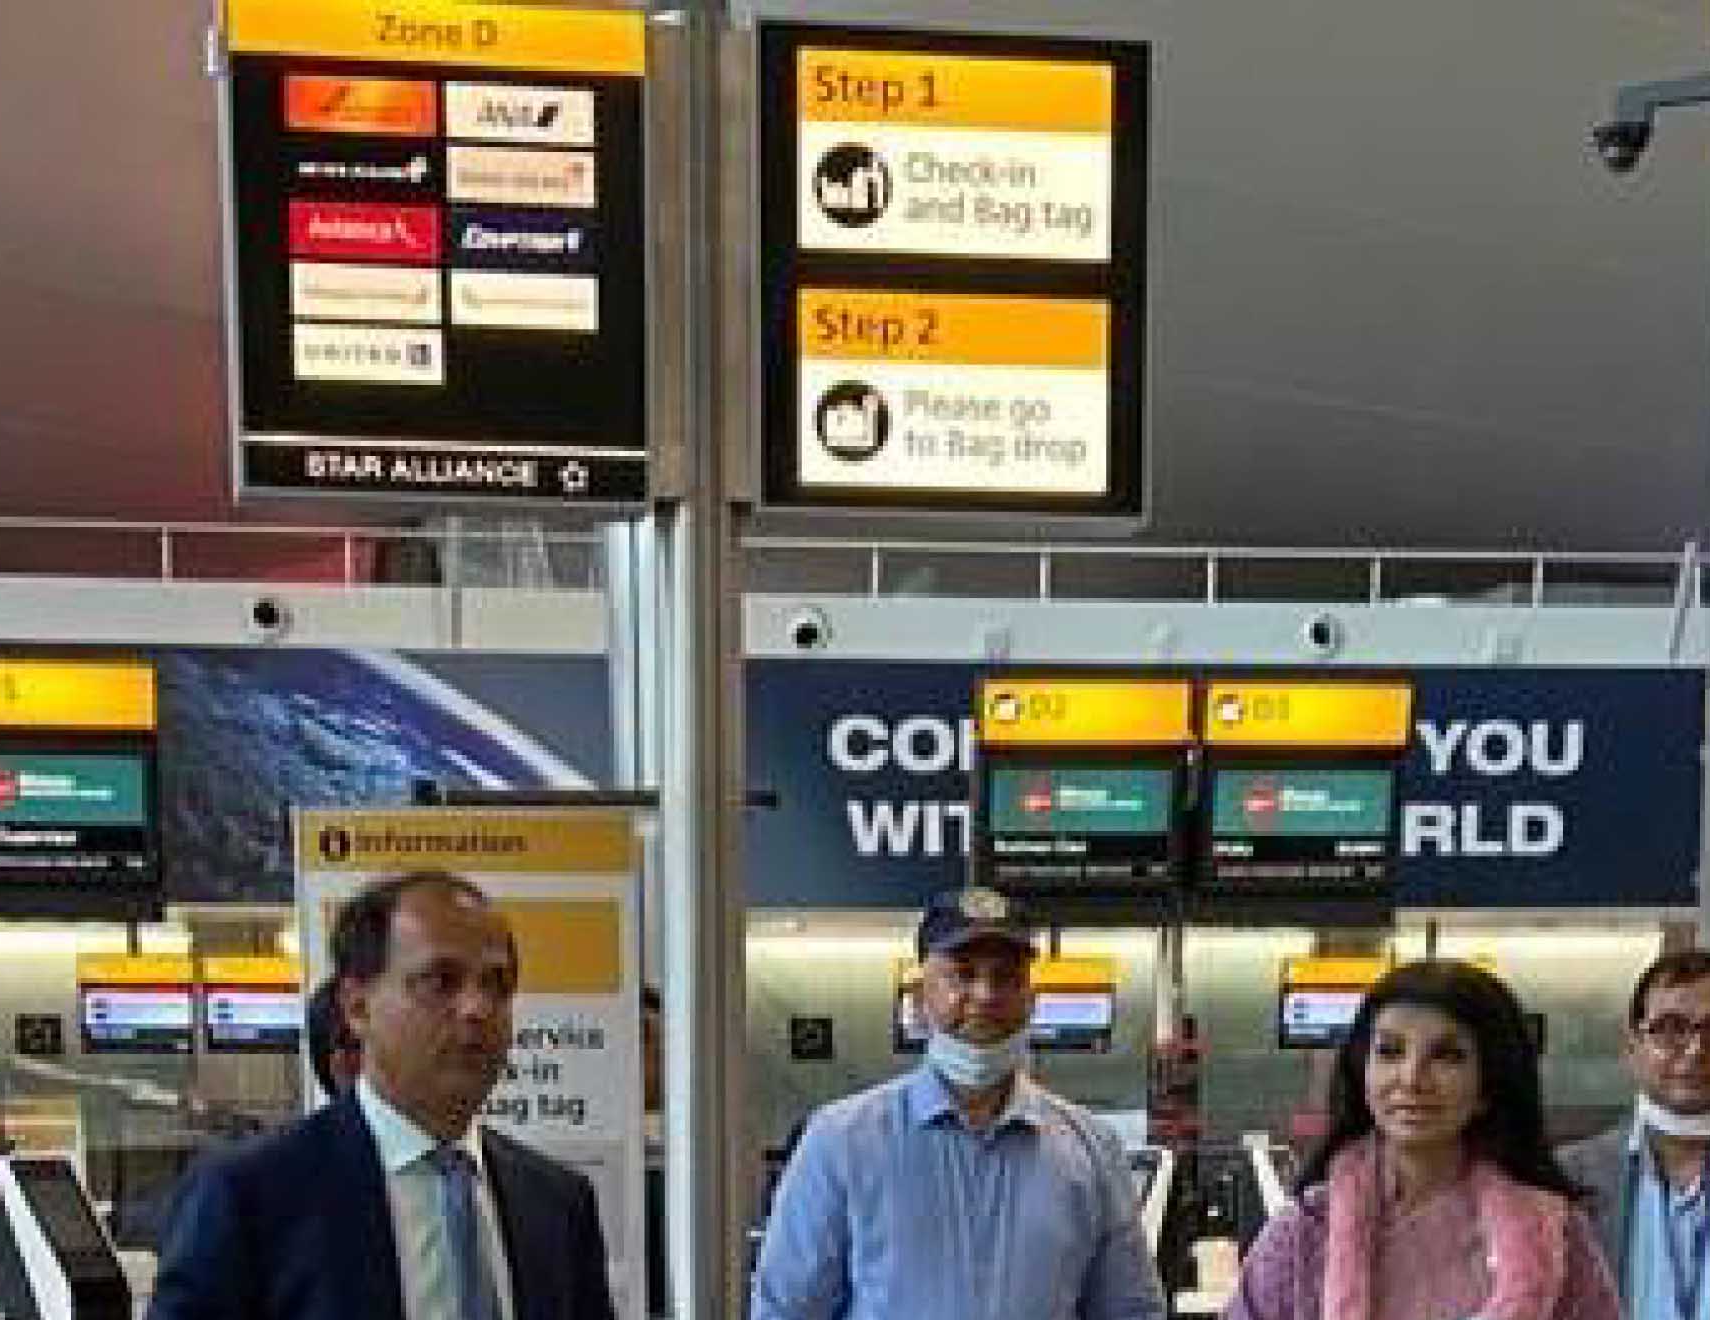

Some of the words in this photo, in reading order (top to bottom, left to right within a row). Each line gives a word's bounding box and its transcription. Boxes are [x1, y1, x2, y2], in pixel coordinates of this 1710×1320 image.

[375, 14, 463, 48] Zone
[471, 18, 499, 47] D
[815, 65, 905, 117] Step
[917, 70, 937, 108] 1
[903, 151, 1037, 188] Check-in
[903, 191, 965, 224] and
[973, 194, 1032, 234] Bag
[1040, 202, 1092, 239] tag
[812, 307, 905, 354] Step
[917, 308, 939, 346] 2
[903, 389, 1001, 422] Please
[1009, 395, 1051, 431] go
[306, 449, 382, 480] STAR
[390, 455, 539, 489] ALLIANCE
[903, 429, 940, 458] to
[944, 430, 1005, 467] Bag
[1013, 430, 1087, 468] drop
[1415, 719, 1585, 776] YOU
